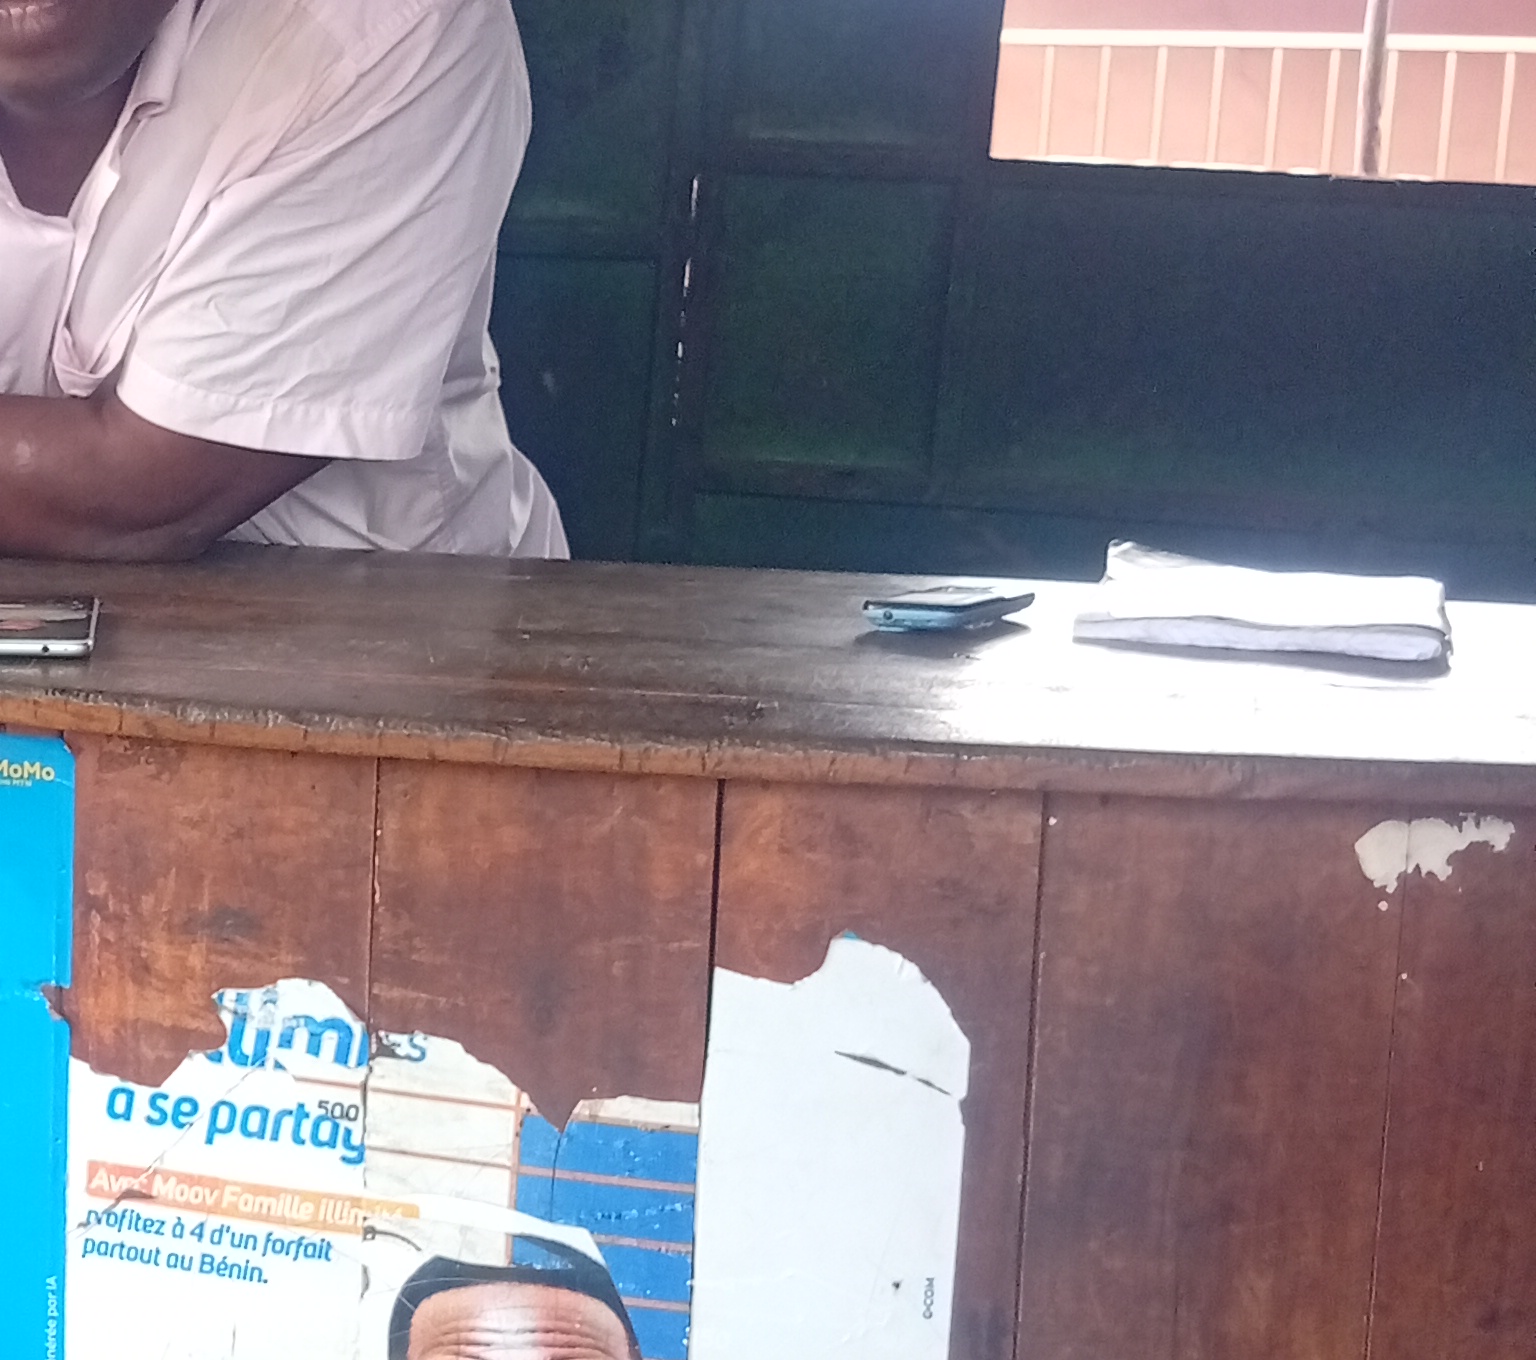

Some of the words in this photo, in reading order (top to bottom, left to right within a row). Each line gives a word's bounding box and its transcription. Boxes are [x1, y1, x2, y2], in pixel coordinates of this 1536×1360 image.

[145, 1091, 199, 1129] se
[316, 1100, 360, 1122] 500
[152, 1174, 220, 1207] Moov
[221, 1186, 315, 1221] Famille
[171, 1217, 184, 1240] à
[190, 1223, 205, 1243] 4
[211, 1225, 258, 1252] d'un
[262, 1232, 333, 1263] forfait
[82, 1237, 162, 1268] partout
[166, 1252, 193, 1272] au
[199, 1253, 270, 1285] Bénin.
[45, 1275, 58, 1290] IA
[47, 1292, 59, 1317] par
